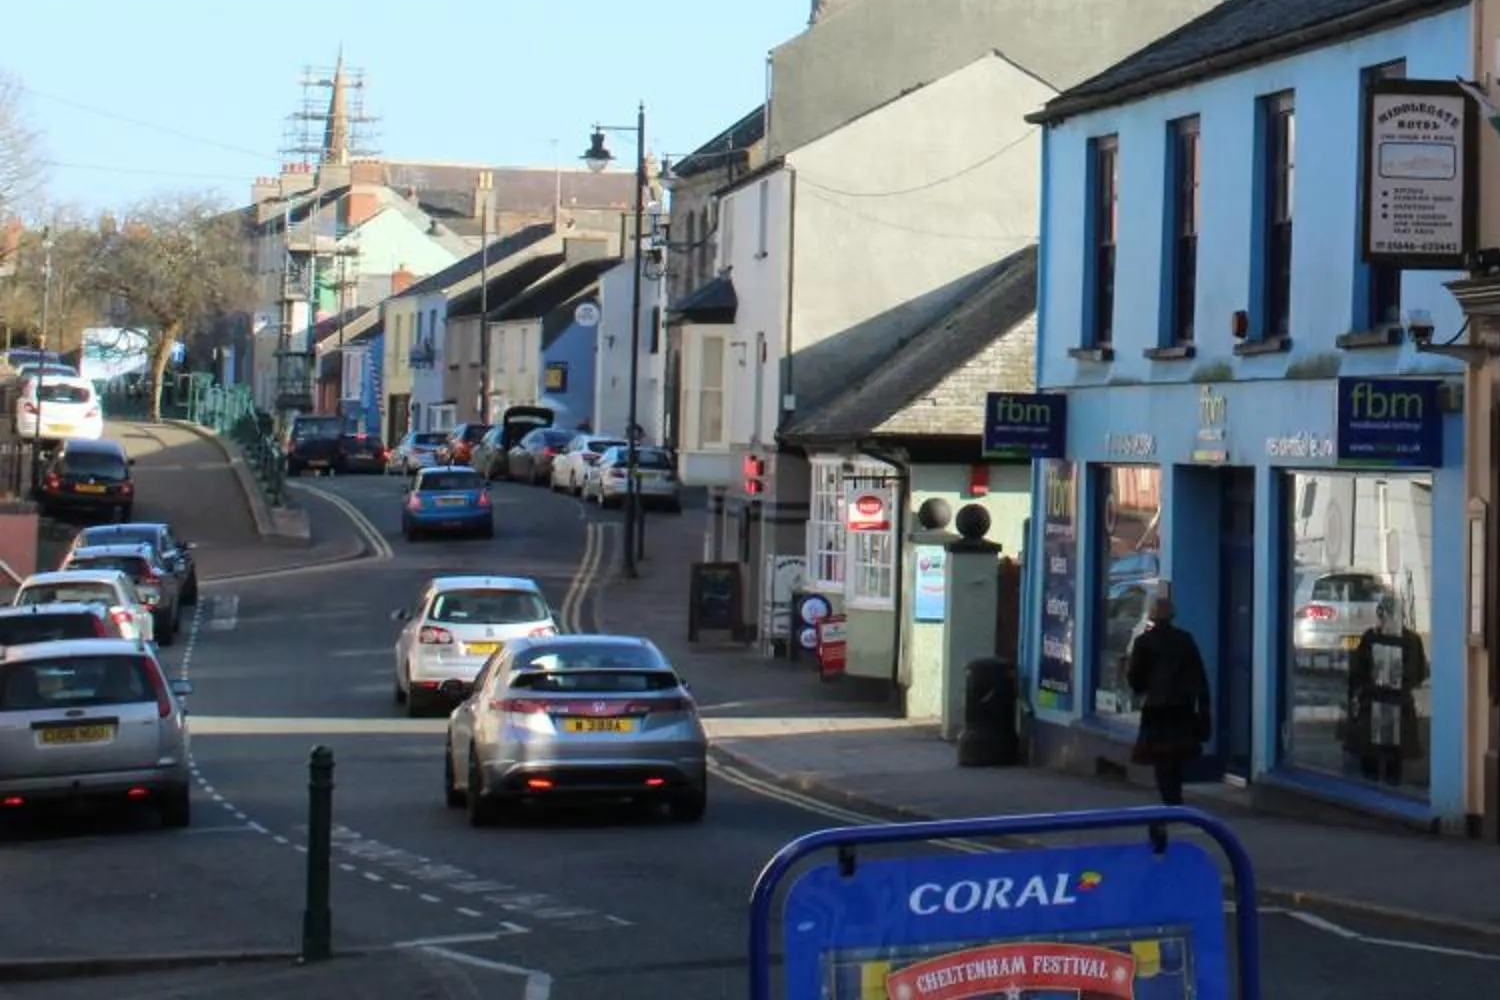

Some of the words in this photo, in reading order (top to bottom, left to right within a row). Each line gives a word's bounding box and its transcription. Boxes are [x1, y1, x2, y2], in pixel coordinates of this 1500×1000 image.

[1378, 103, 1459, 128] MIDDLEGATE
[996, 396, 1051, 424] fbm
[1351, 383, 1422, 419] fbm
[909, 872, 1077, 915] CORAL
[916, 955, 1027, 993] CHELTENHAM
[1033, 955, 1109, 981] FESTIVAL
